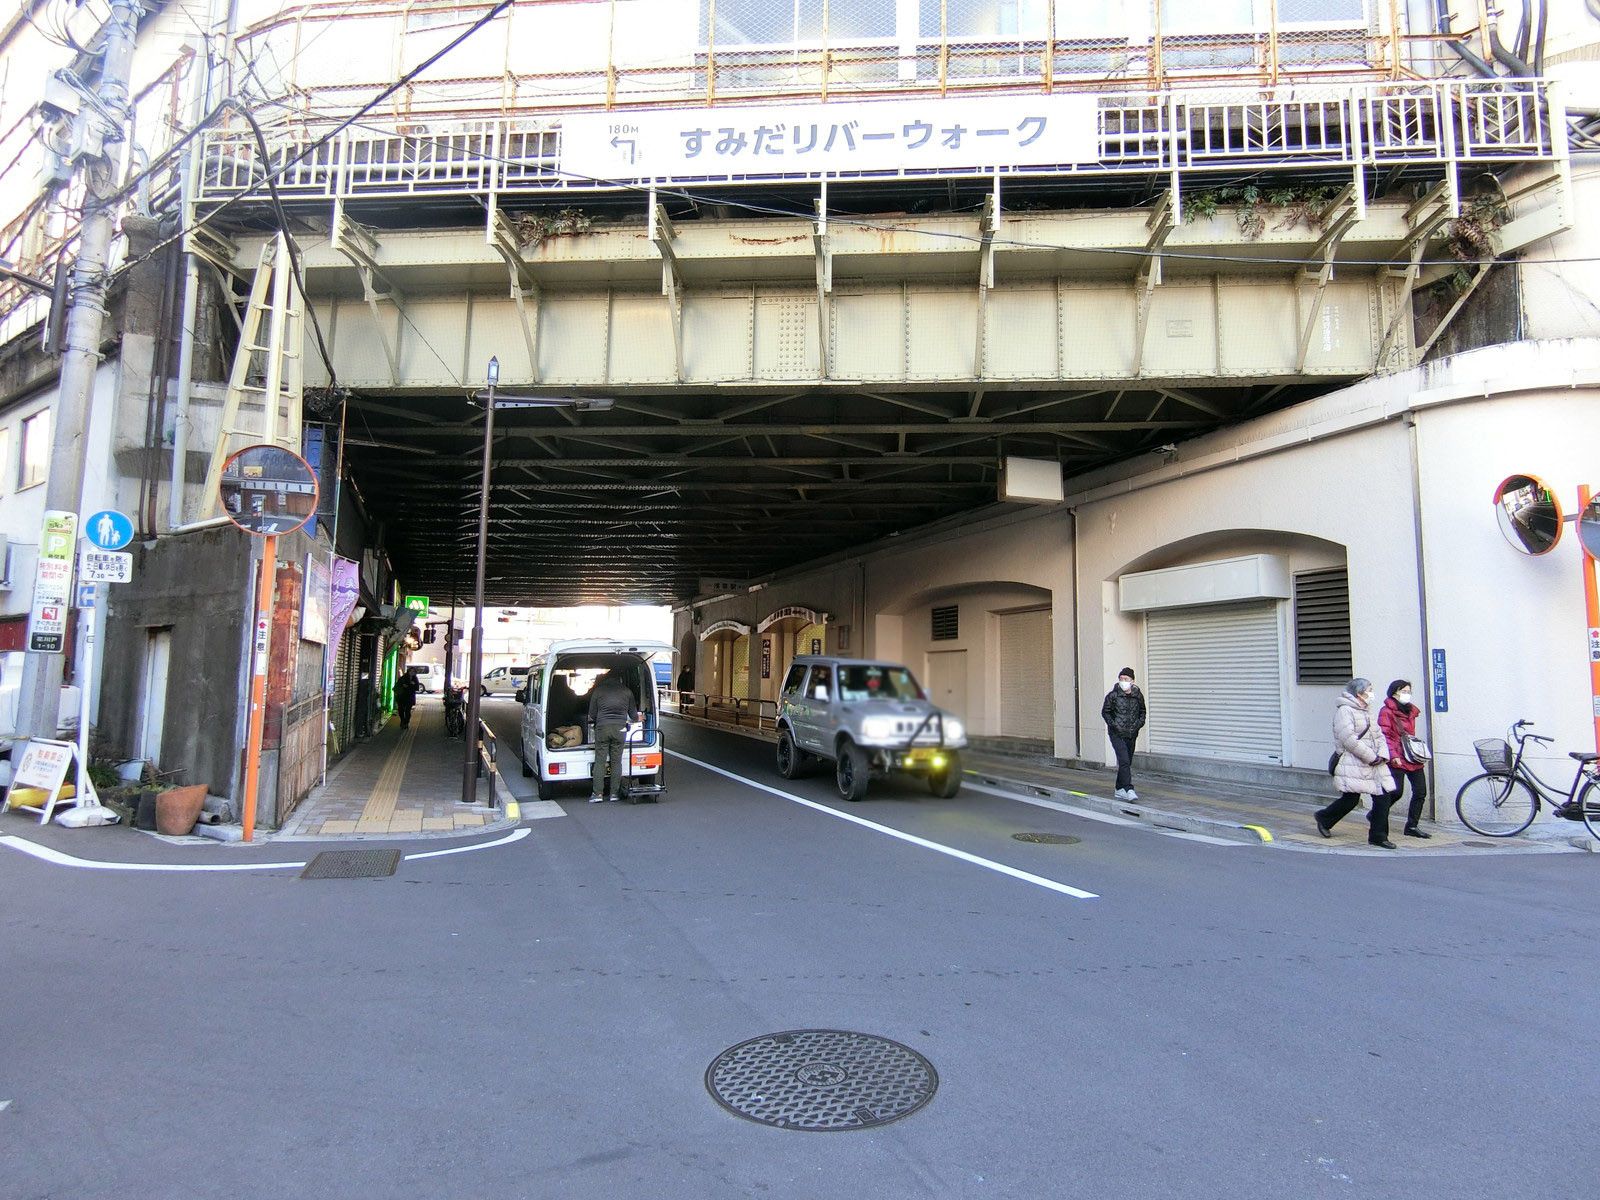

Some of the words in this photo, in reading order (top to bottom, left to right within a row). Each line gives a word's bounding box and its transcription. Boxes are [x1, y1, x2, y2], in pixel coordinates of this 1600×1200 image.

[609, 124, 639, 134] 180M
[680, 116, 1047, 159] すみだリバーウォーク
[49, 535, 66, 552] P
[257, 630, 266, 651] 注意
[1439, 700, 1445, 708] 4
